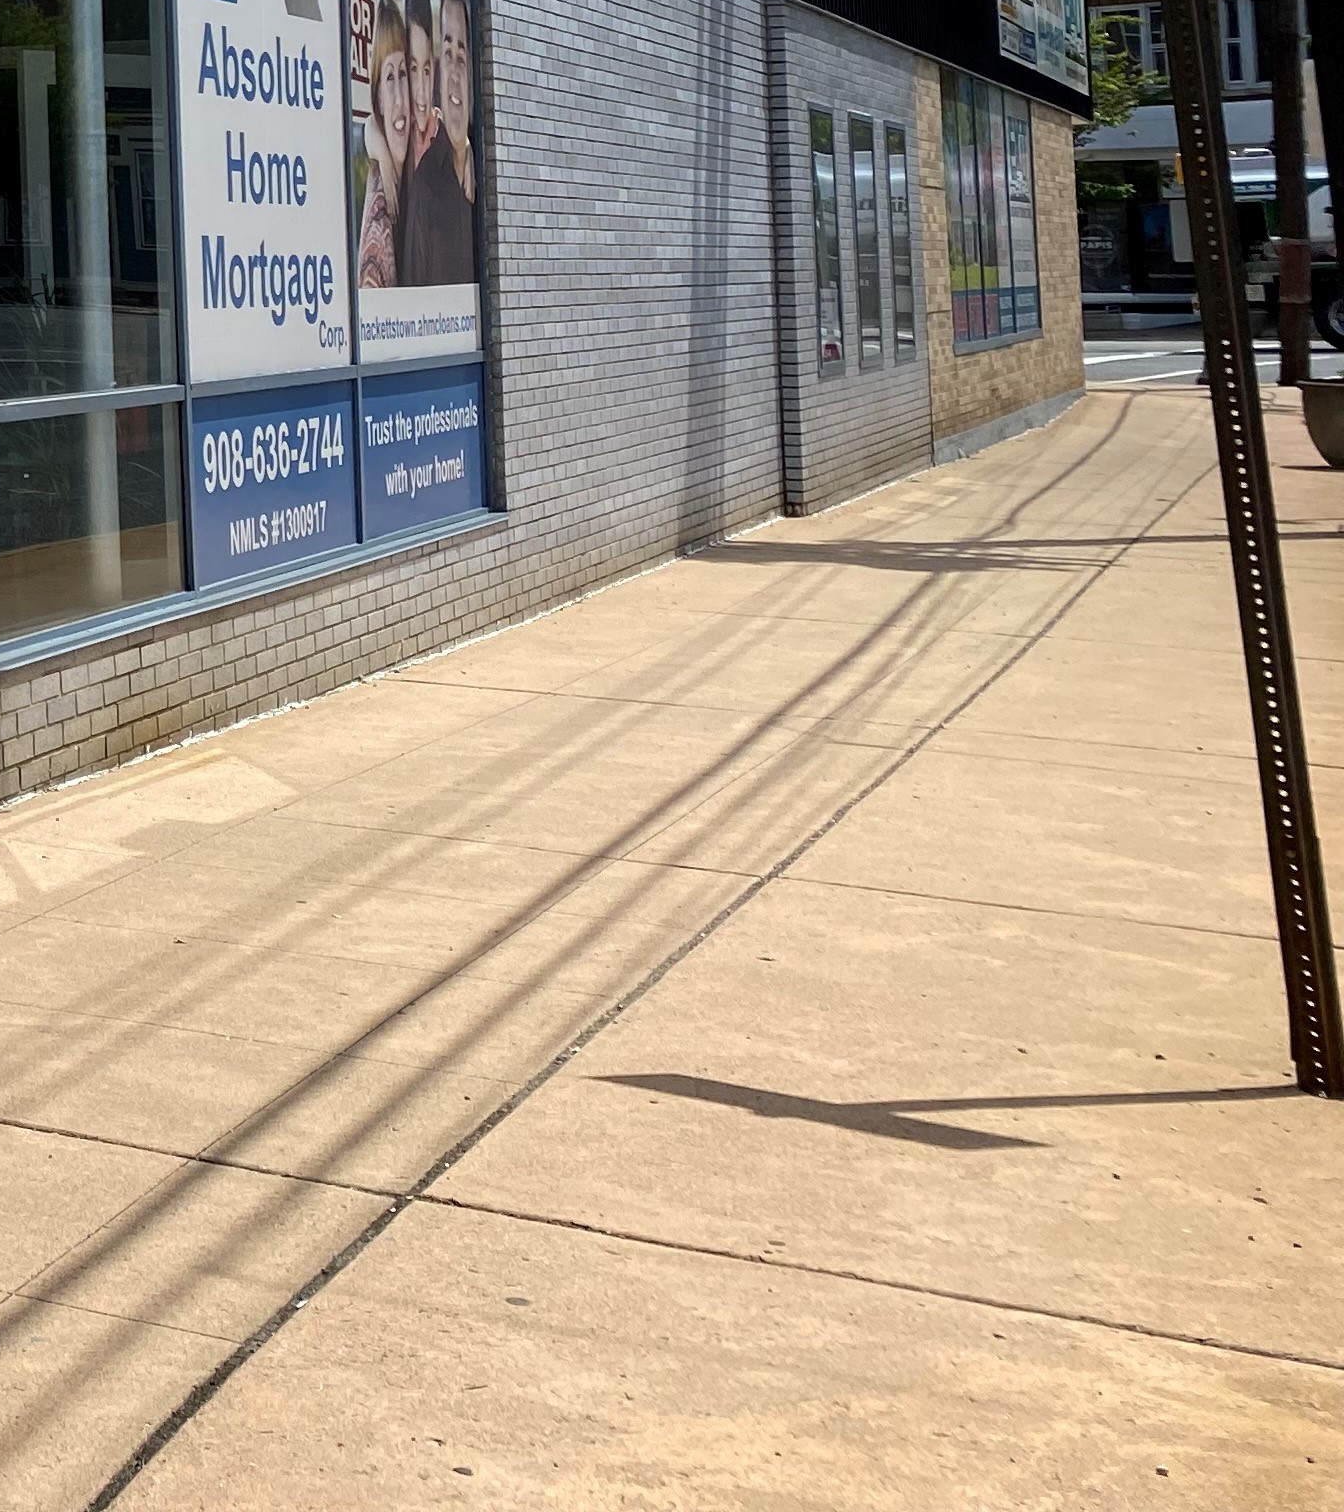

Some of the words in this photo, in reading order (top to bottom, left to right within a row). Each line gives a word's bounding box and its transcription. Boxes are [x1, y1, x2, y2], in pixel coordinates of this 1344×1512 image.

[198, 22, 324, 109] Absolute
[225, 130, 307, 206] Home
[201, 235, 334, 326] Mortgage
[319, 320, 348, 354] Corp.
[203, 412, 344, 493] 908-636-2744
[364, 414, 394, 447] Trust
[395, 409, 412, 442] the
[414, 398, 479, 445] professionals
[385, 462, 408, 497] with
[410, 464, 433, 499] your
[434, 449, 465, 486] home!
[230, 509, 268, 556] NMLS
[271, 500, 327, 545] #1300917
